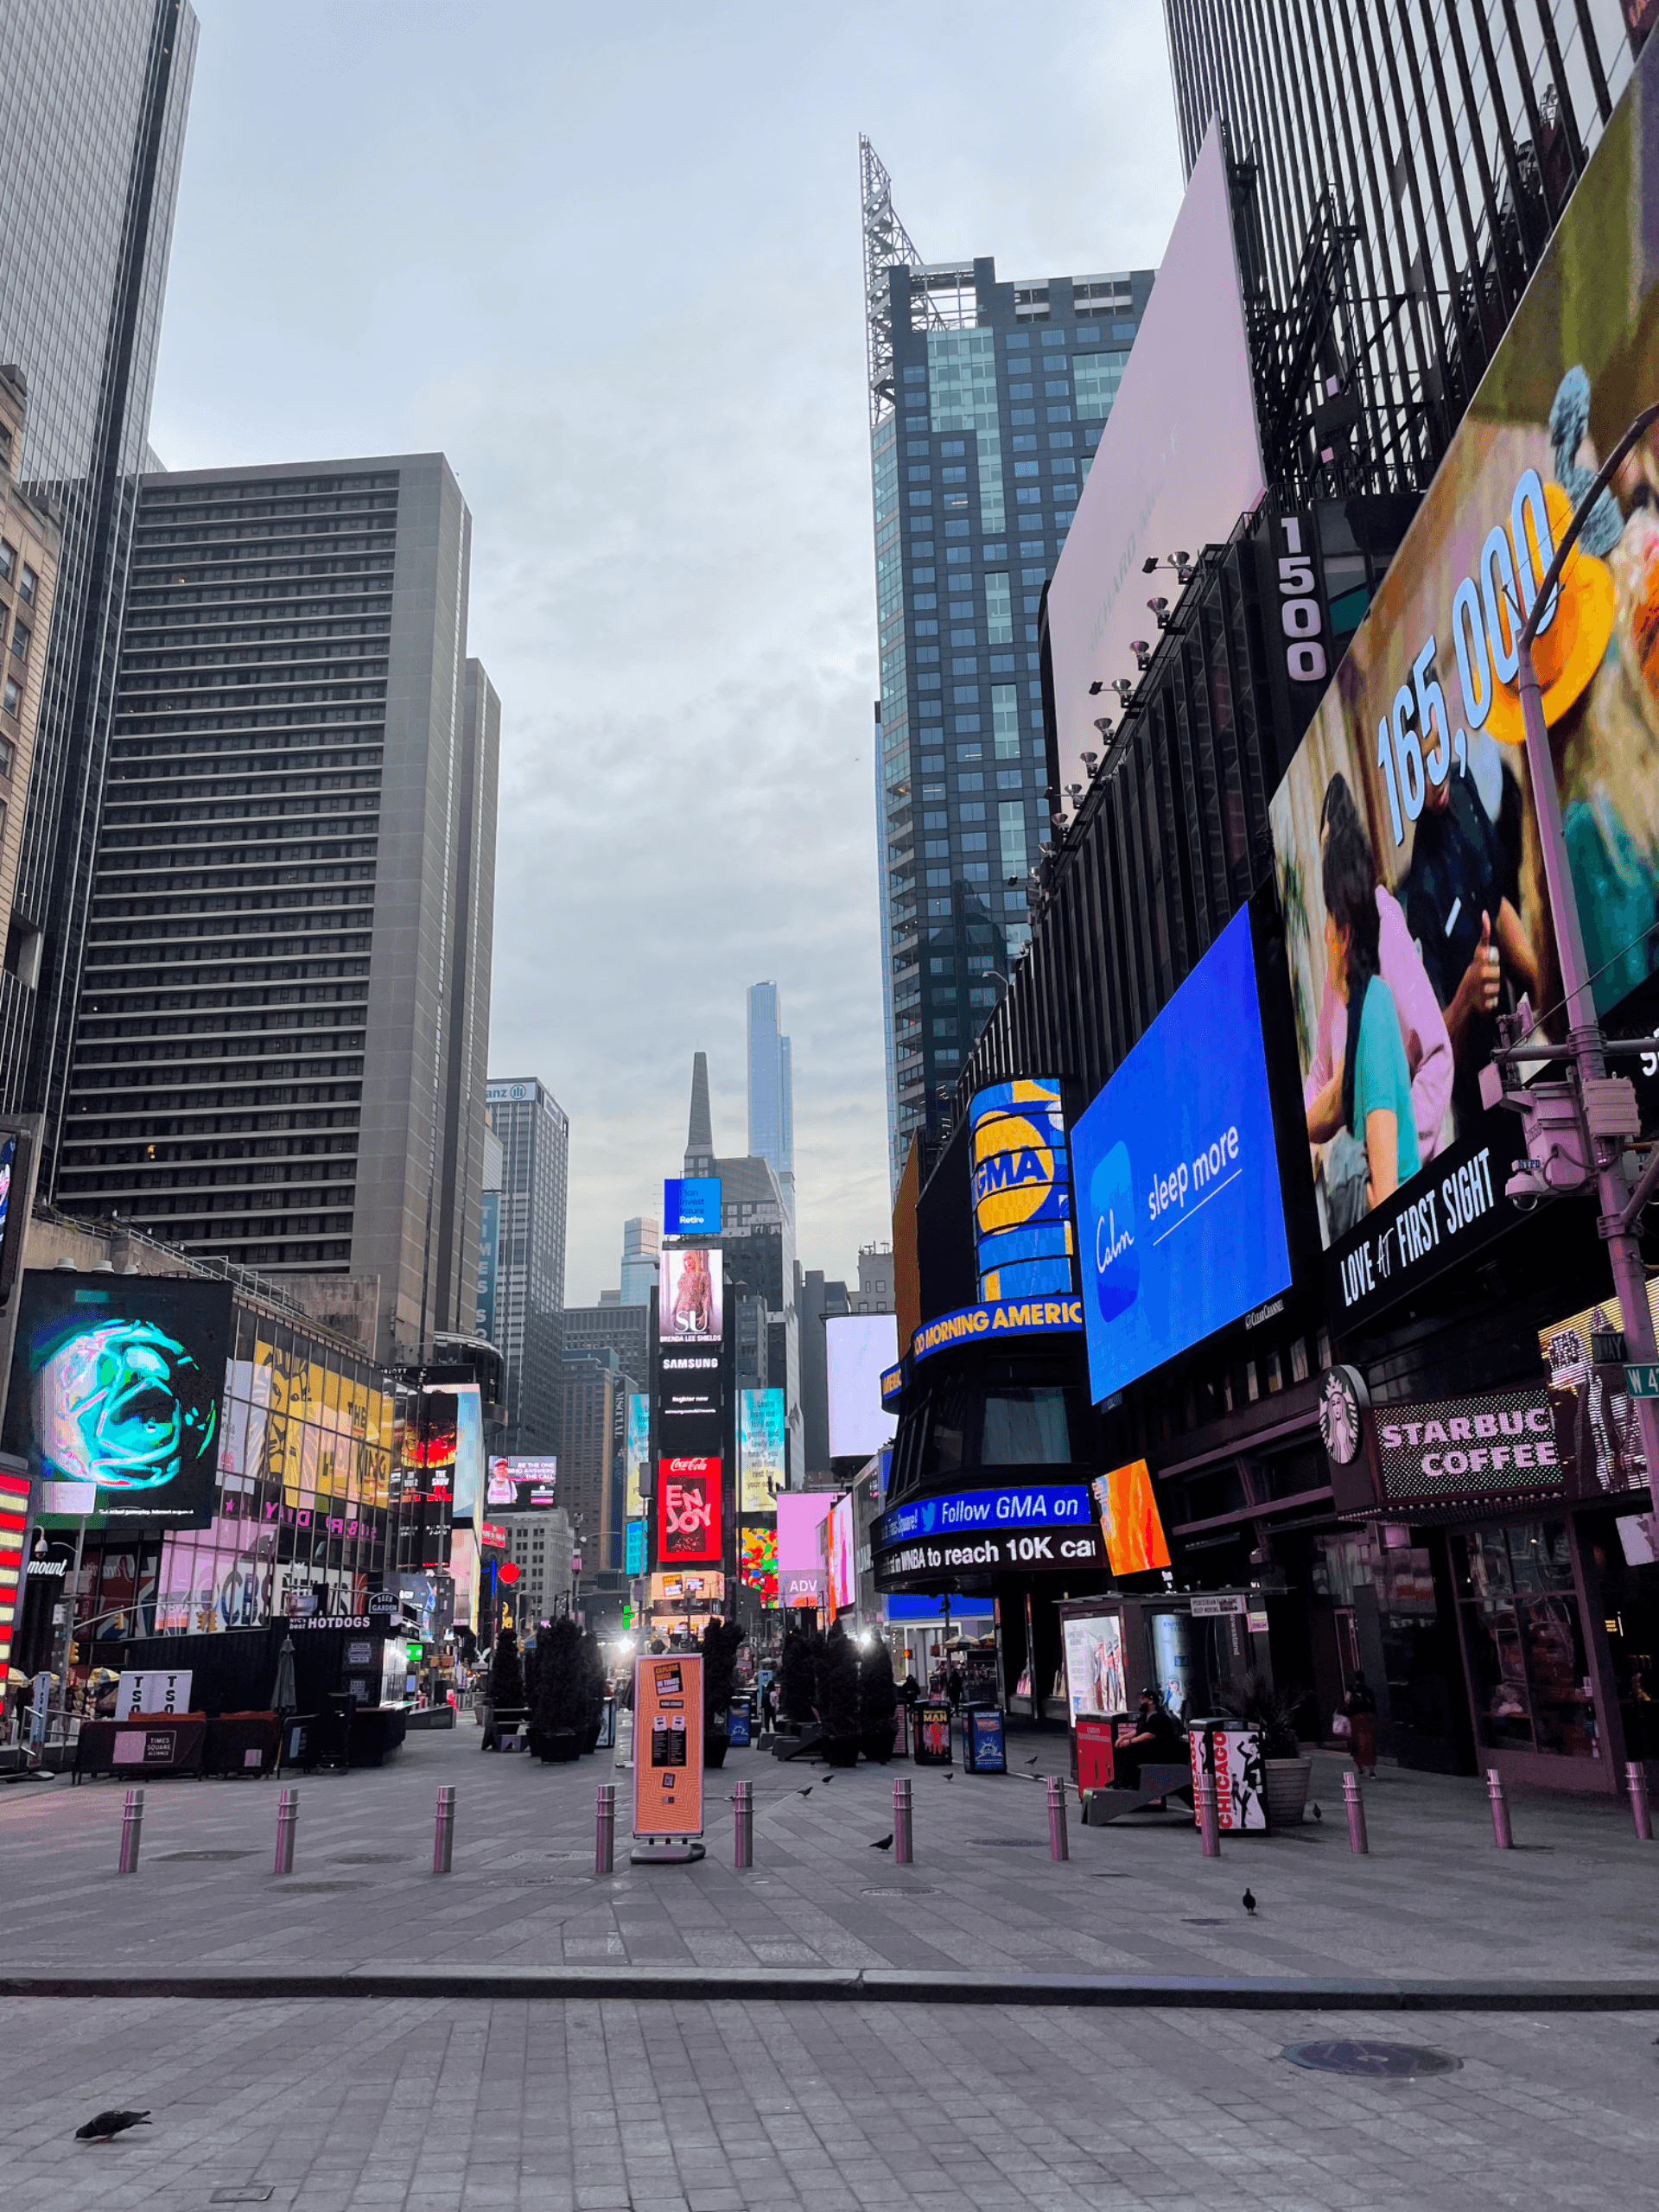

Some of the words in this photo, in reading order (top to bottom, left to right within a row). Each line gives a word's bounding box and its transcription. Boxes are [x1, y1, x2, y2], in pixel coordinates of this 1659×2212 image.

[1278, 517, 1326, 681] 1500
[1378, 469, 1559, 845] 165,000
[976, 1145, 1049, 1199] GMA
[1148, 1162, 1188, 1221] sleep
[1192, 1126, 1239, 1191] more
[679, 1216, 705, 1224] Retire
[1341, 1241, 1376, 1306] LOVE
[1377, 1228, 1394, 1278] AT
[1396, 1190, 1440, 1267] FIRST
[1442, 1147, 1494, 1234] SIGHT
[1096, 1209, 1135, 1274] Calm
[674, 1310, 709, 1332] SU
[925, 1311, 989, 1349] MORNING
[663, 1357, 719, 1370] SAMSUNG
[1628, 1369, 1643, 1394] W
[1649, 1368, 1659, 1393] 4
[1421, 1441, 1557, 1477] COFFEE
[666, 1485, 704, 1510] EN
[942, 1501, 990, 1524] Follow
[996, 1495, 1047, 1519] GMA
[1054, 1499, 1078, 1516] on
[666, 1503, 712, 1533] JOY
[27, 1559, 67, 1577] mount
[900, 1548, 926, 1572] WNBA
[928, 1548, 941, 1566] to
[944, 1541, 999, 1565] reach
[1006, 1536, 1054, 1560] 10K
[790, 1580, 817, 1592] ADV
[308, 1617, 371, 1629] HOTDOGS
[923, 1713, 948, 1722] MAN
[1212, 1731, 1233, 1830] CHICAGO
